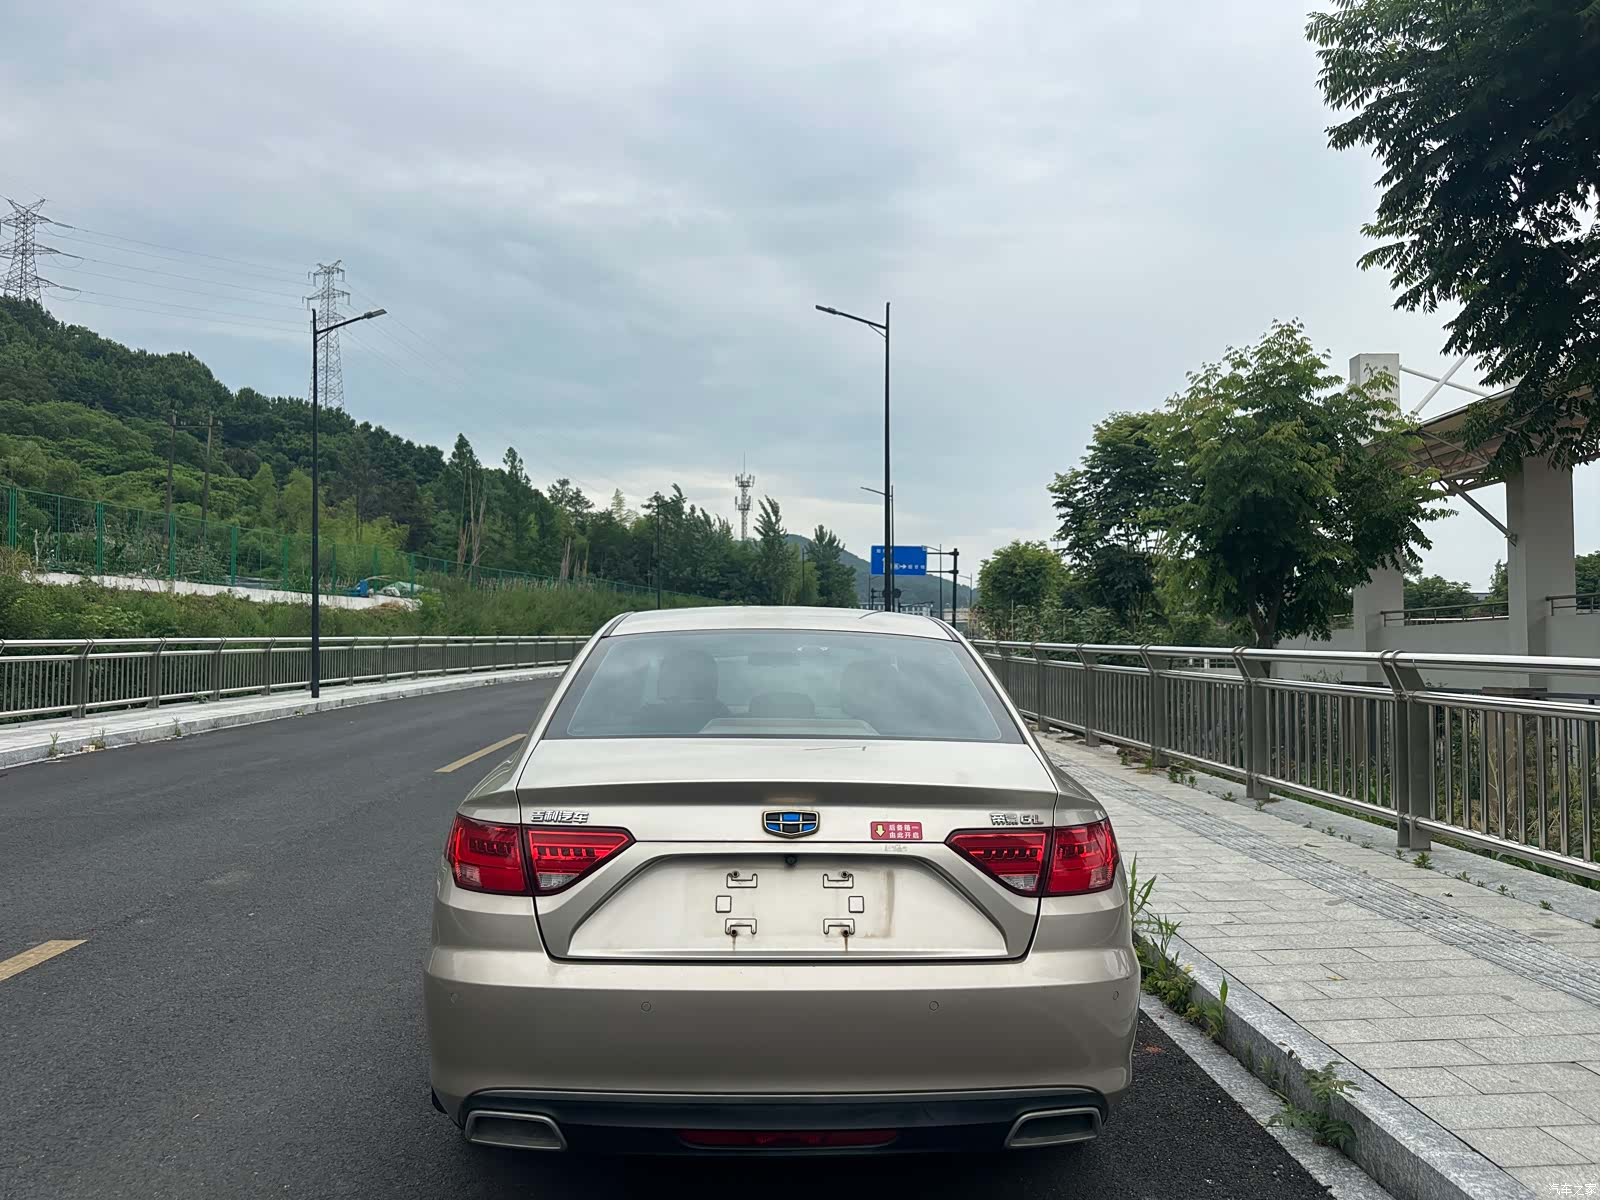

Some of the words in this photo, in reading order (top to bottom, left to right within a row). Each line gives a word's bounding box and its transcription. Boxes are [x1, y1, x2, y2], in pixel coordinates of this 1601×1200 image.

[531, 810, 589, 824] 吉利汽车
[889, 831, 920, 839] 由此开启
